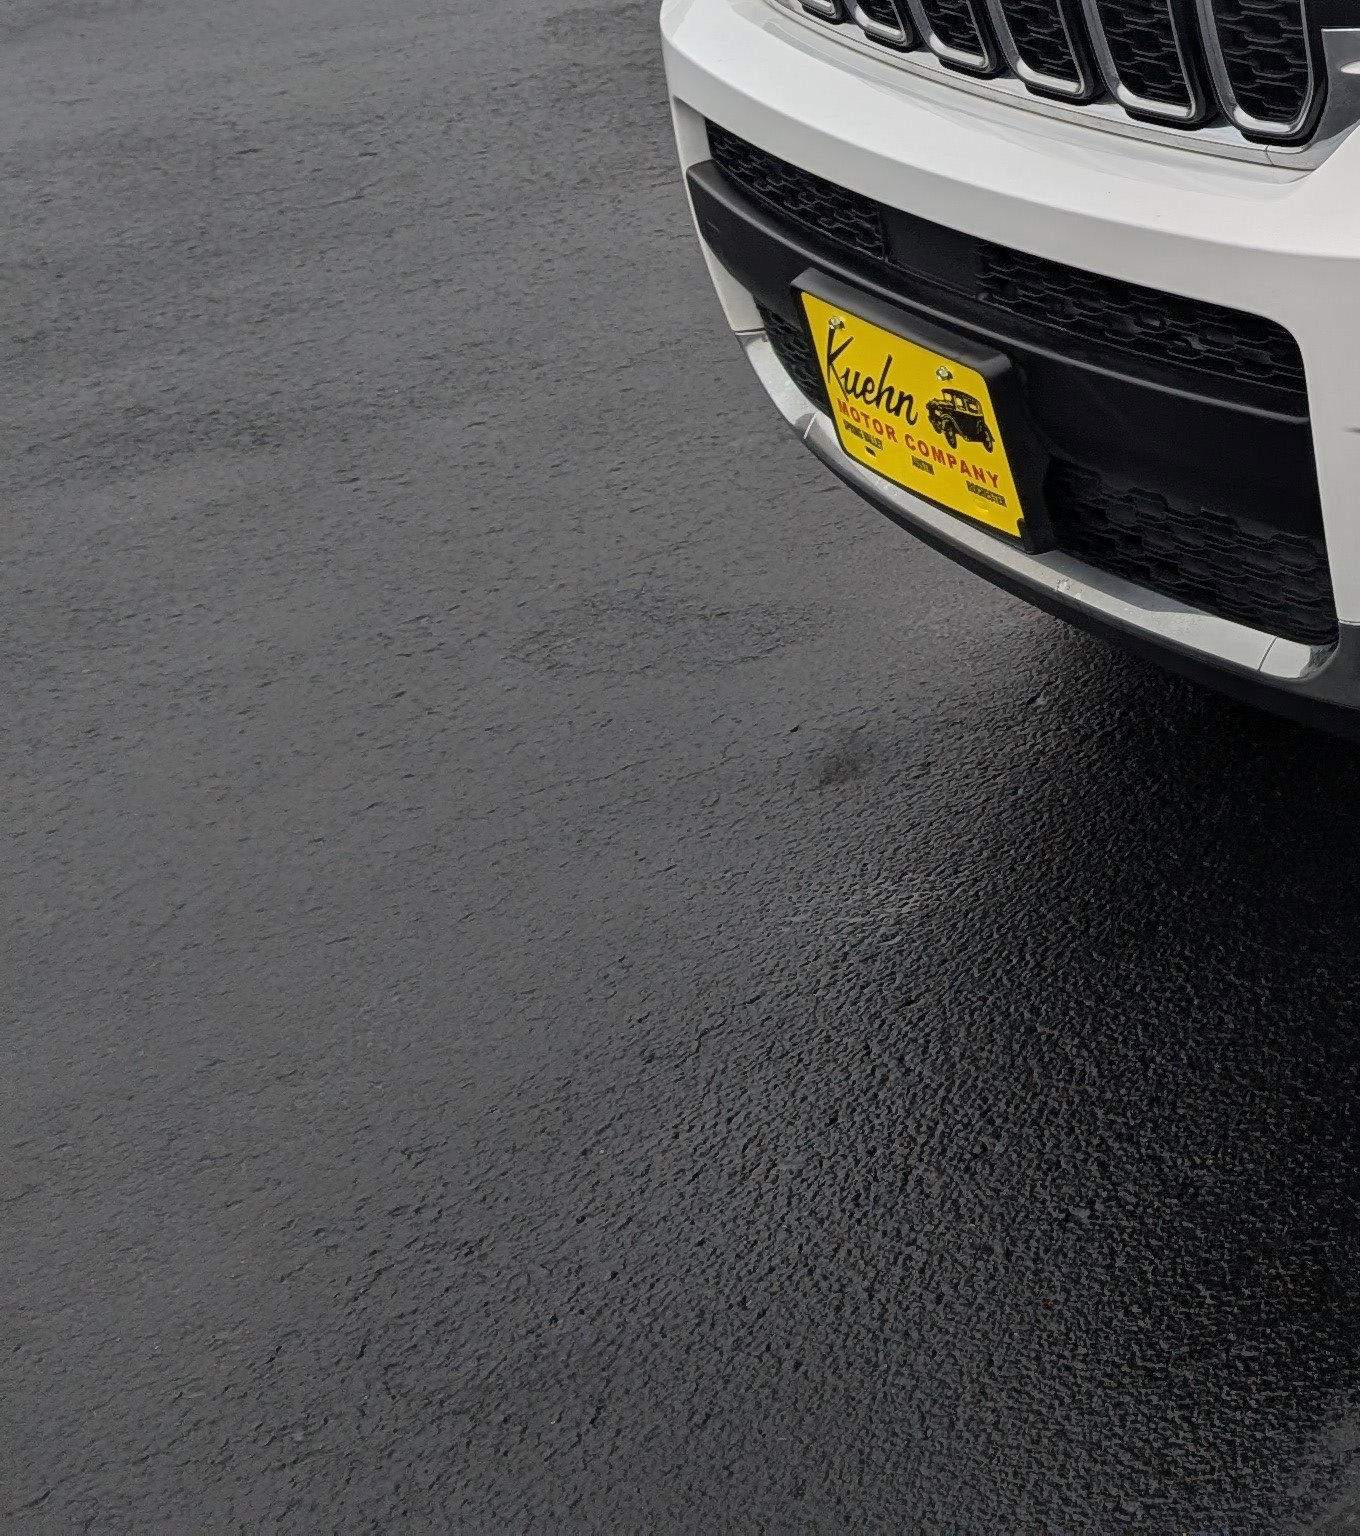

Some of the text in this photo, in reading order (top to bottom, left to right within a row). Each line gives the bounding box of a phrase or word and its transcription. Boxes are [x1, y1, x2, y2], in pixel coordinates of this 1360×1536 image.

[826, 324, 918, 426] Kuehn
[836, 397, 1000, 489] MOTOR COMPANY
